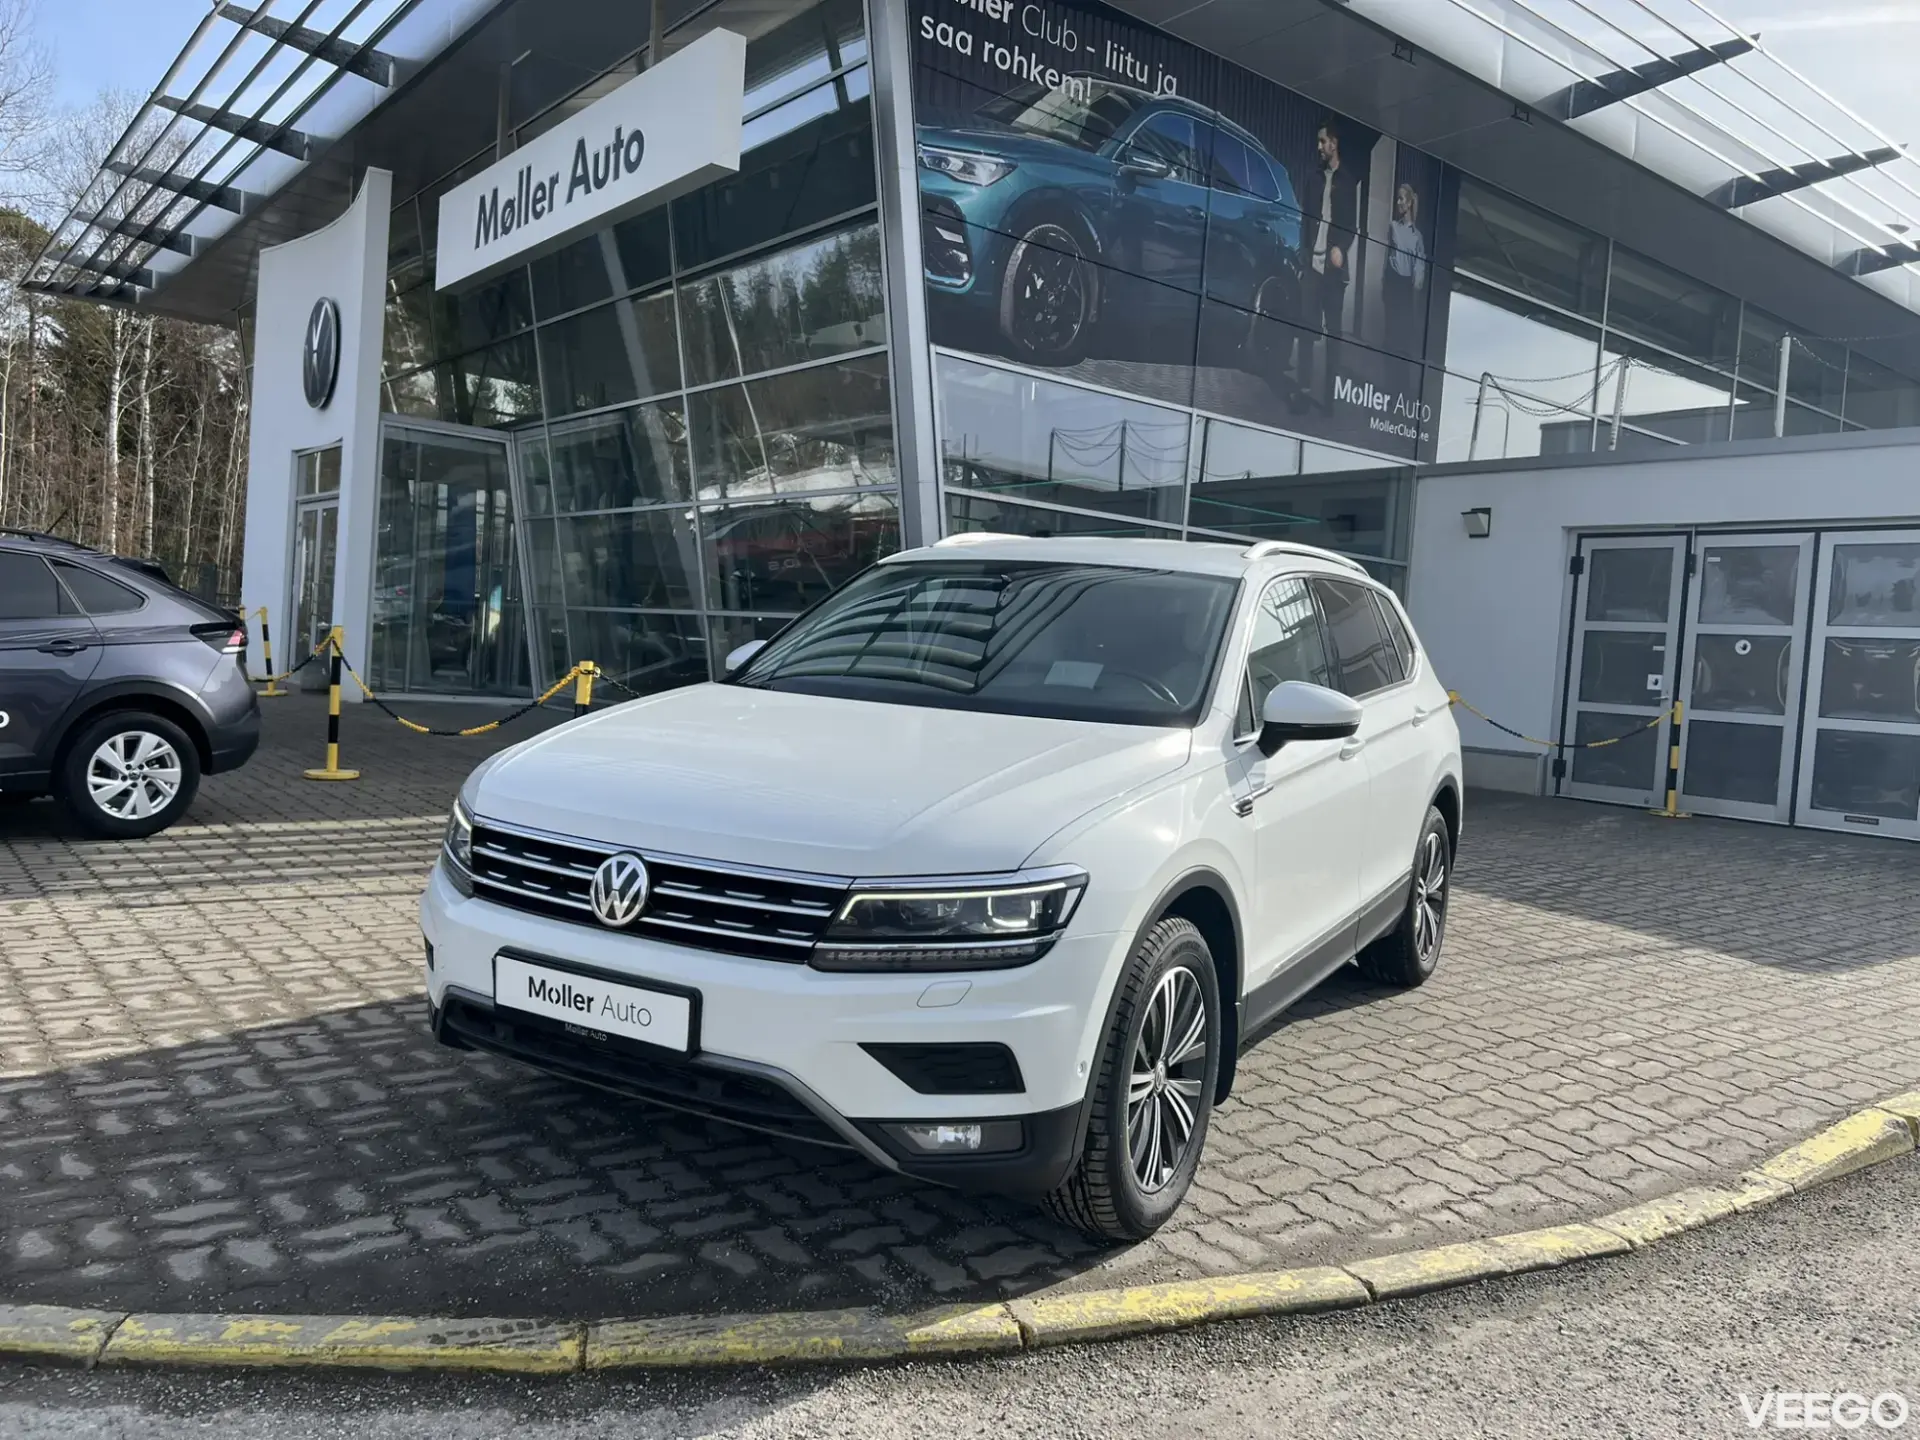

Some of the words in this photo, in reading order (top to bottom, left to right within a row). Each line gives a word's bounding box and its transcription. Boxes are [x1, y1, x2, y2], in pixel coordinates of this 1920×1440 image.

[921, 15, 973, 56] saa
[983, 40, 1092, 104] rohkem!
[1022, 5, 1078, 52] Club
[1105, 40, 1148, 84] liitu
[1153, 63, 1177, 97] ja
[475, 163, 560, 250] Møller
[565, 124, 645, 205] Auto
[1394, 393, 1431, 423] Auto
[601, 995, 652, 1027] Auto
